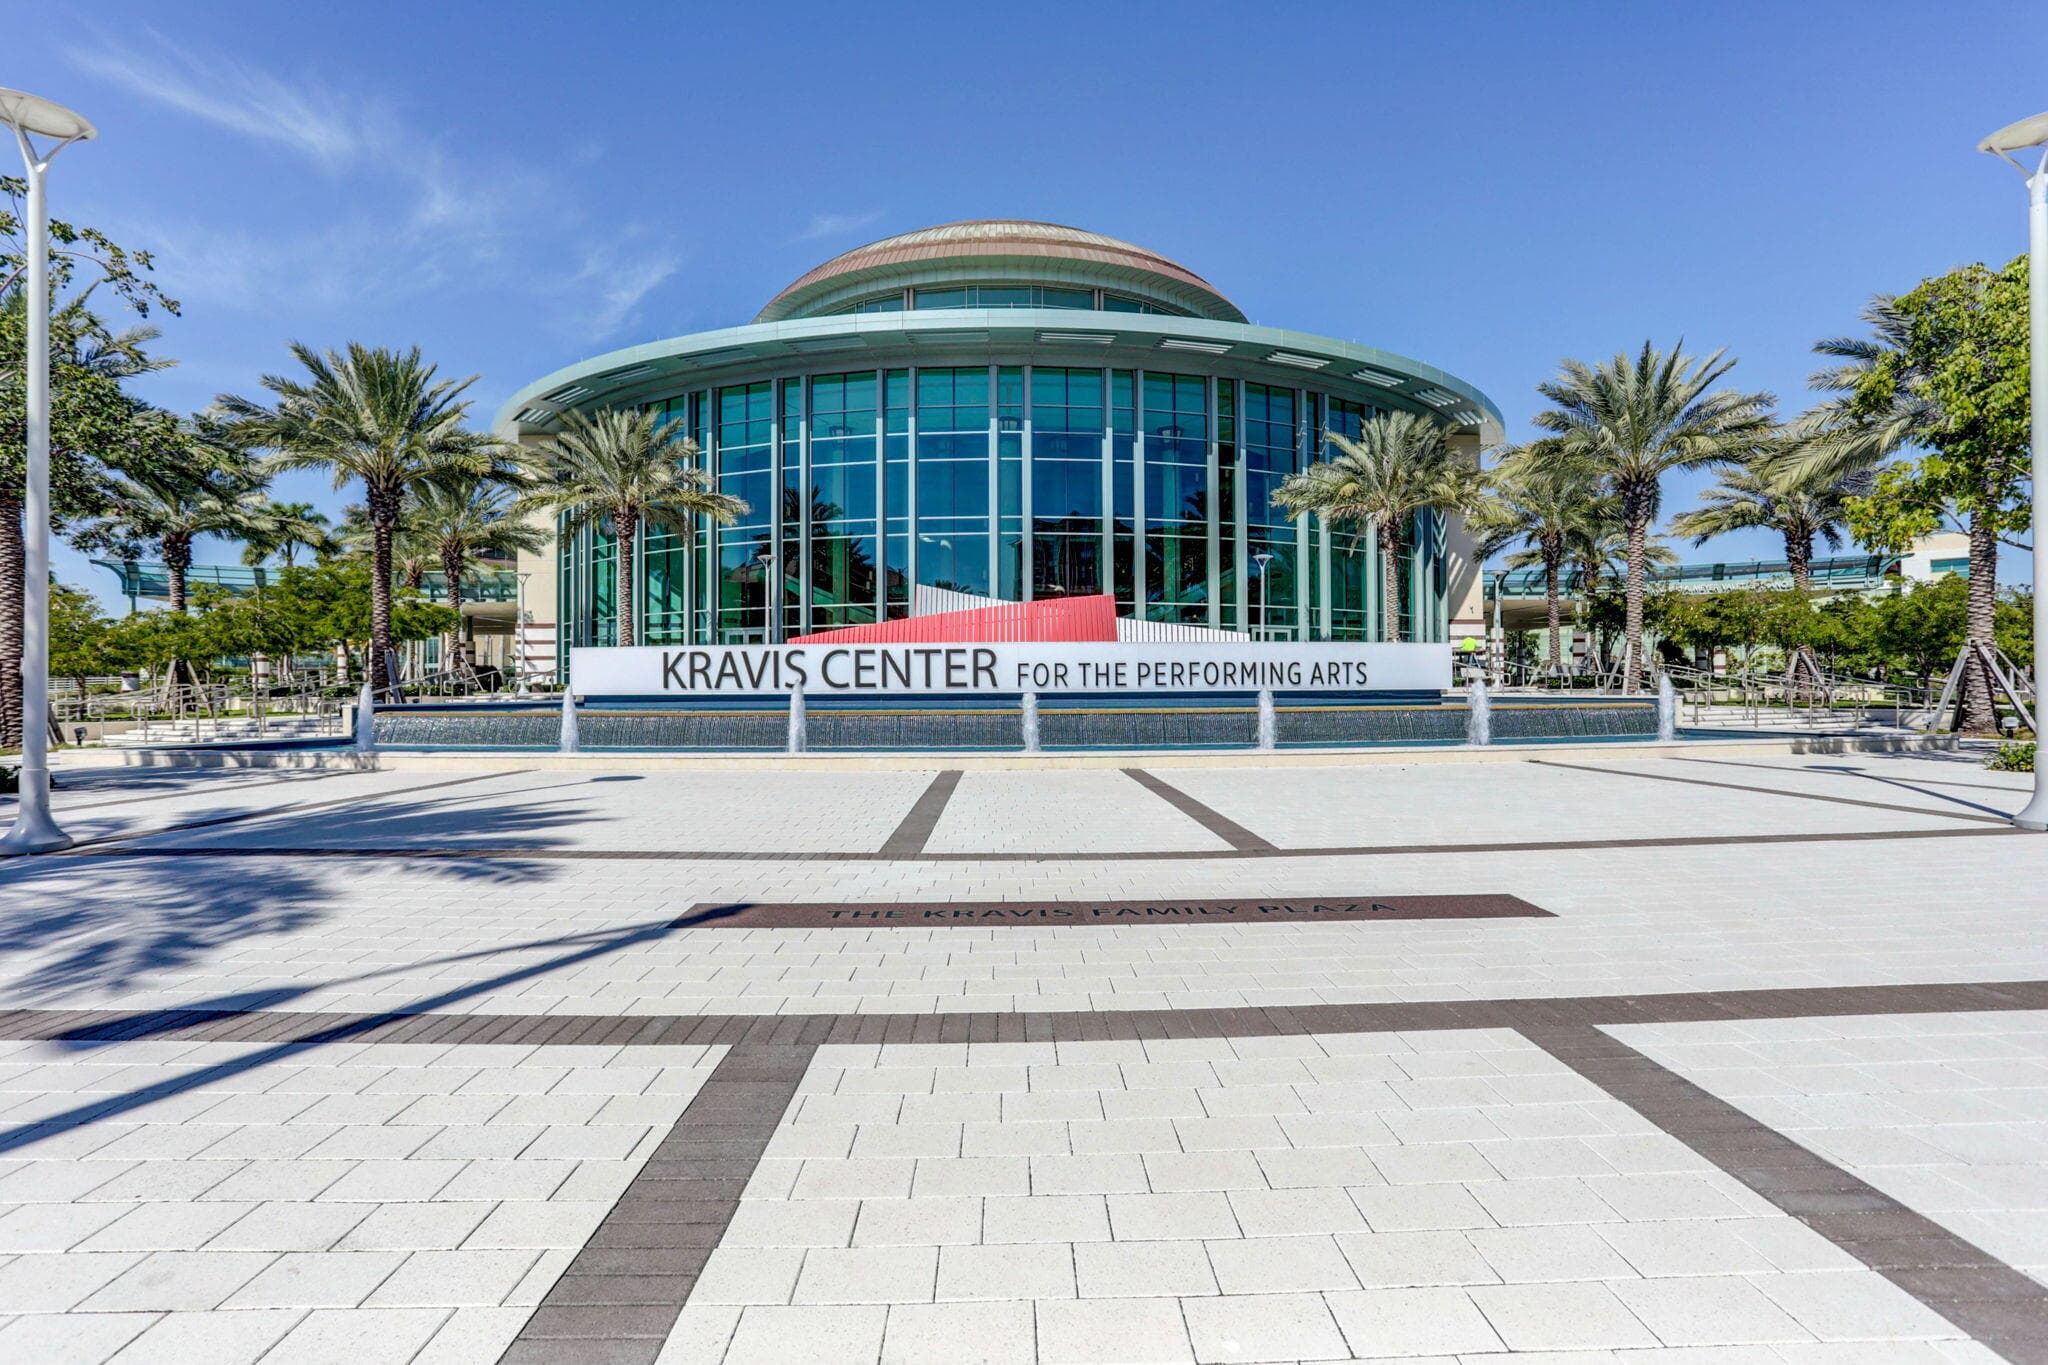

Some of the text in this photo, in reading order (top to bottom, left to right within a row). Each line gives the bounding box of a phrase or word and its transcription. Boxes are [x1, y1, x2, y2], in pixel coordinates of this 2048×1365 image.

[662, 648, 1368, 689] KRAVIS CENTER FOR THE PERFORMING ARTS
[828, 903, 1397, 919] THE KRAVIS FAMILY PLAZA
